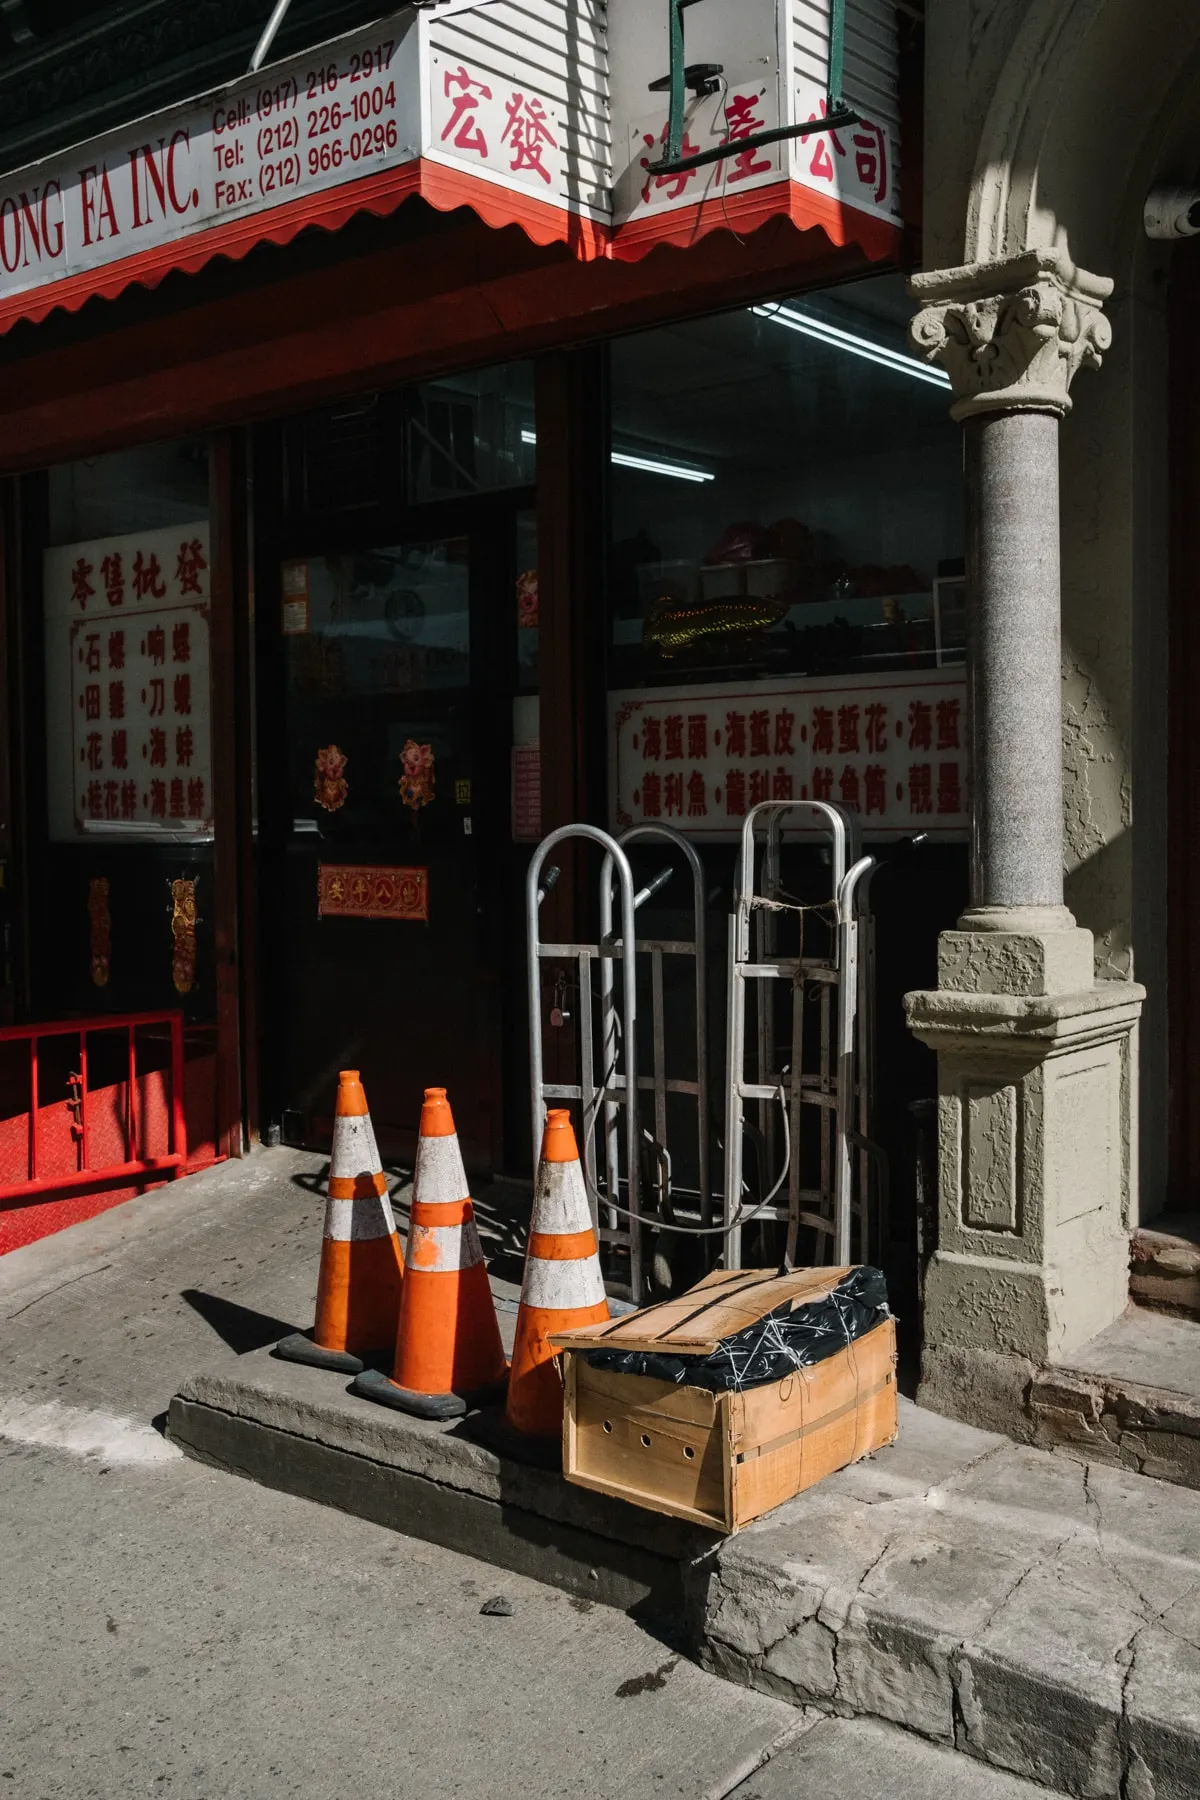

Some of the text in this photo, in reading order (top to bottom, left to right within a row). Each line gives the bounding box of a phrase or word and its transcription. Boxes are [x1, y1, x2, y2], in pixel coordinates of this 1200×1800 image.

[212, 39, 395, 135] Cell: (917) 216-2917
[213, 81, 396, 171] Tel: (212) 226-1004
[214, 119, 397, 208] Fax: (212) 966-0296
[441, 66, 557, 184] 宏發
[801, 98, 887, 203] 公司
[0, 126, 199, 274] ONG FA INC.
[908, 698, 968, 751] 海蜇
